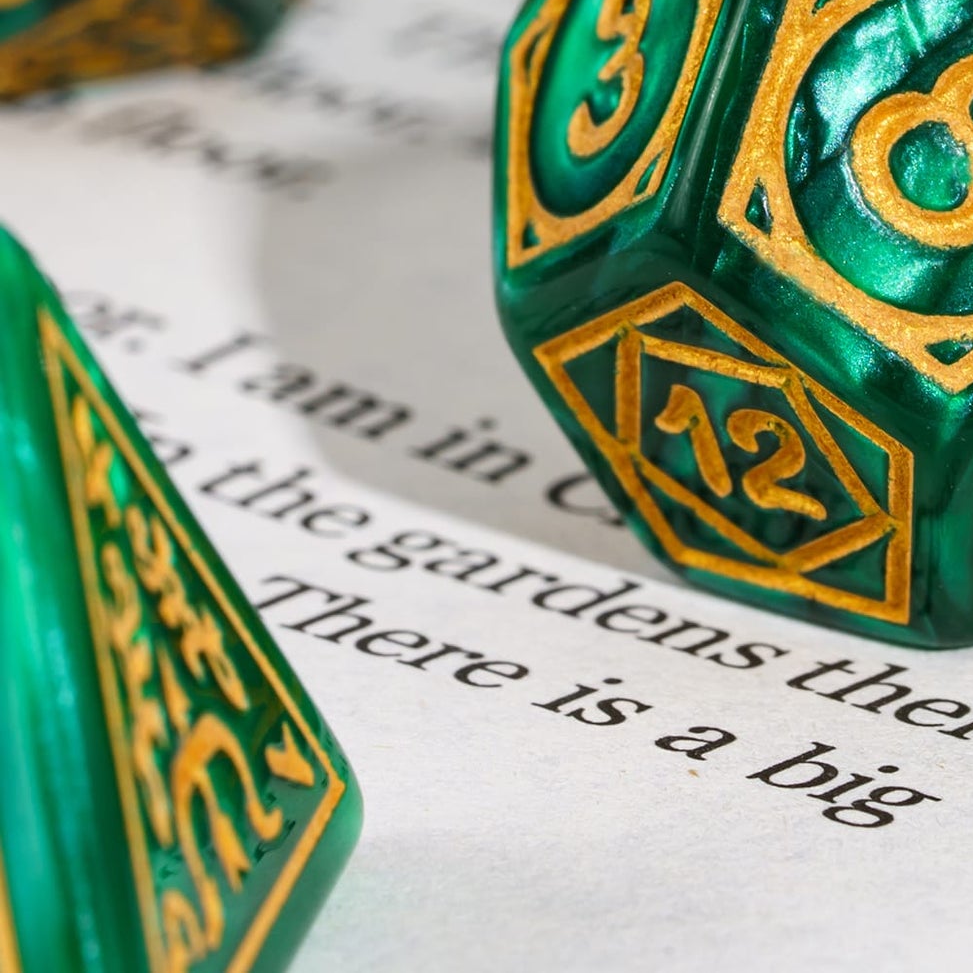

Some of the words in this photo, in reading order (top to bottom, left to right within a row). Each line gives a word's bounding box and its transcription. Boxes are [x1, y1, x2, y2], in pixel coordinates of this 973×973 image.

[238, 362, 414, 444] am
[408, 415, 532, 484] in
[655, 383, 828, 521] 12
[199, 459, 372, 538] the
[345, 529, 791, 672] gardens
[253, 575, 531, 689] There
[531, 677, 654, 730] is
[653, 724, 738, 762] a
[745, 741, 942, 829] big
